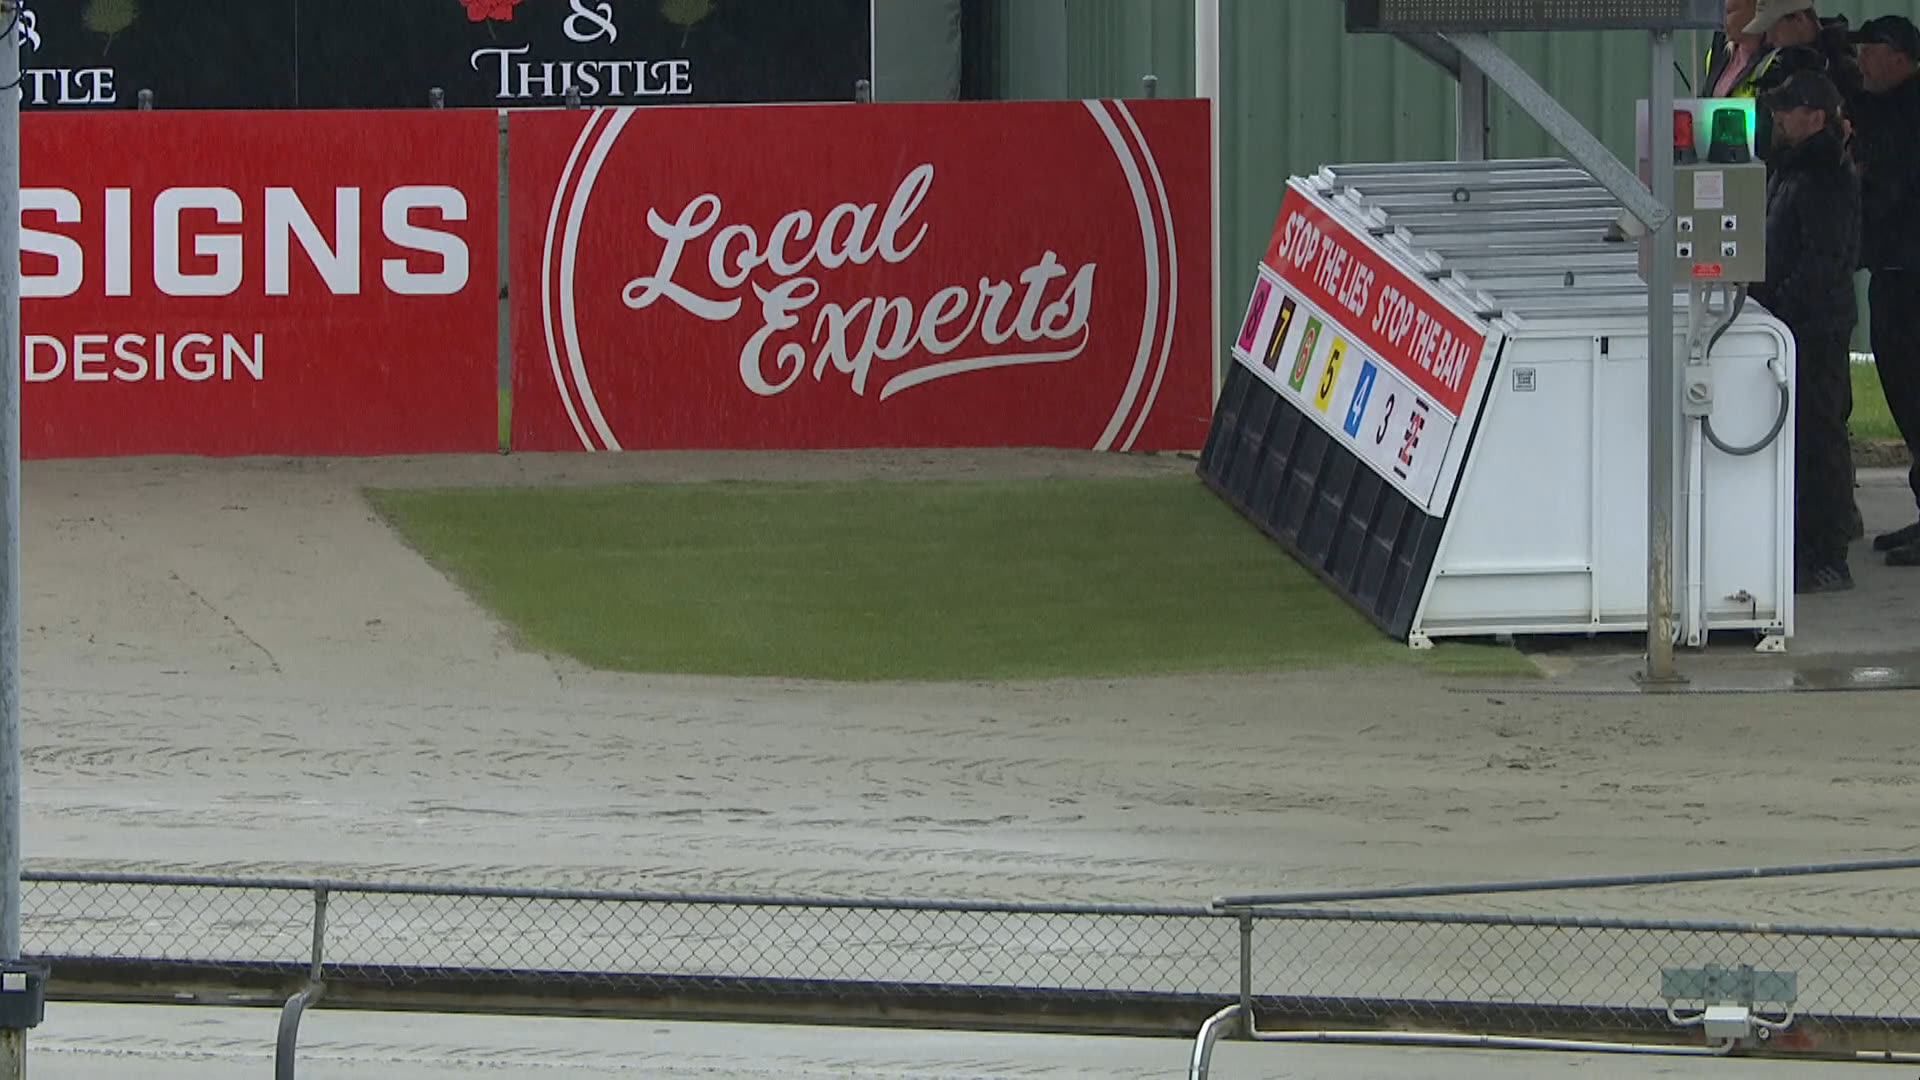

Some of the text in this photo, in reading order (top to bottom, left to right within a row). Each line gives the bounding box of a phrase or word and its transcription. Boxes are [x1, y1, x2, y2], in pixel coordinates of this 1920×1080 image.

[563, 0, 617, 43] &
[19, 185, 470, 297] SIGNS
[622, 163, 934, 320] Local
[1279, 210, 1471, 392] STOP THE LIES STOP THE BAN
[24, 333, 265, 381] DESIGN
[739, 250, 1097, 401] Experts
[1245, 290, 1266, 340] 8
[1269, 308, 1291, 359] 7
[1294, 327, 1316, 382] 6
[1320, 349, 1340, 400] 5
[1352, 375, 1371, 426] 4
[1376, 393, 1395, 445] 3
